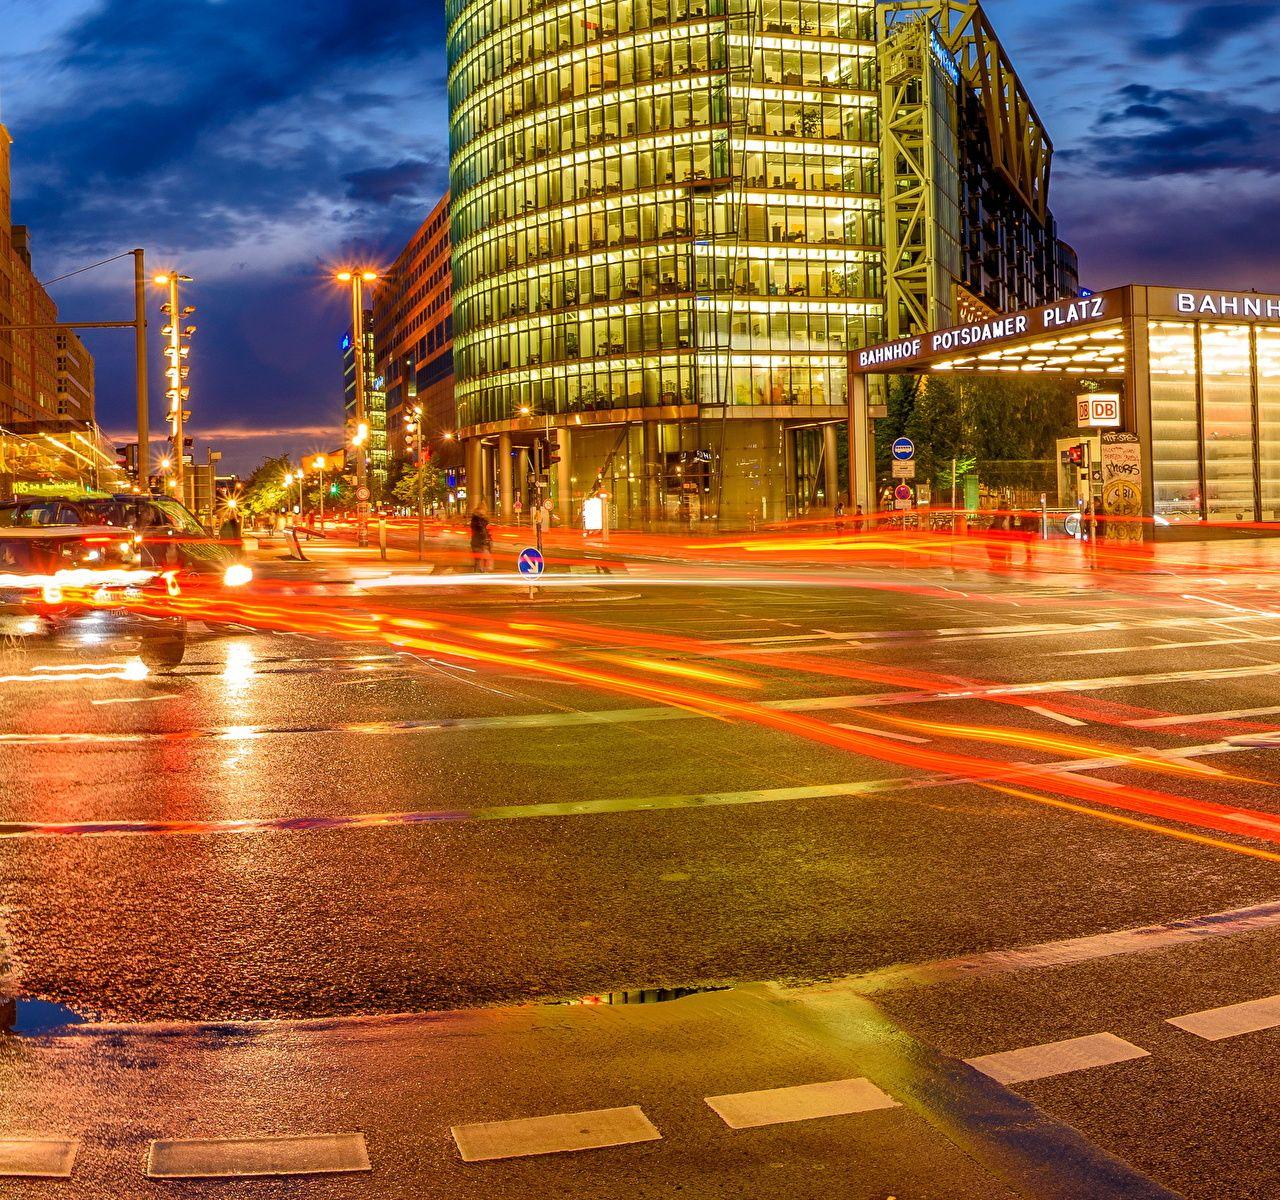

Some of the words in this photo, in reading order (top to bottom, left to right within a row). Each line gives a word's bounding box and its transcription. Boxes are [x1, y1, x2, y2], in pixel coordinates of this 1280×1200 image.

[859, 339, 920, 366] BAHNHOF
[932, 315, 1027, 351] POTSDAMER
[1043, 298, 1103, 327] PLATZ
[1095, 403, 1114, 417] DB
